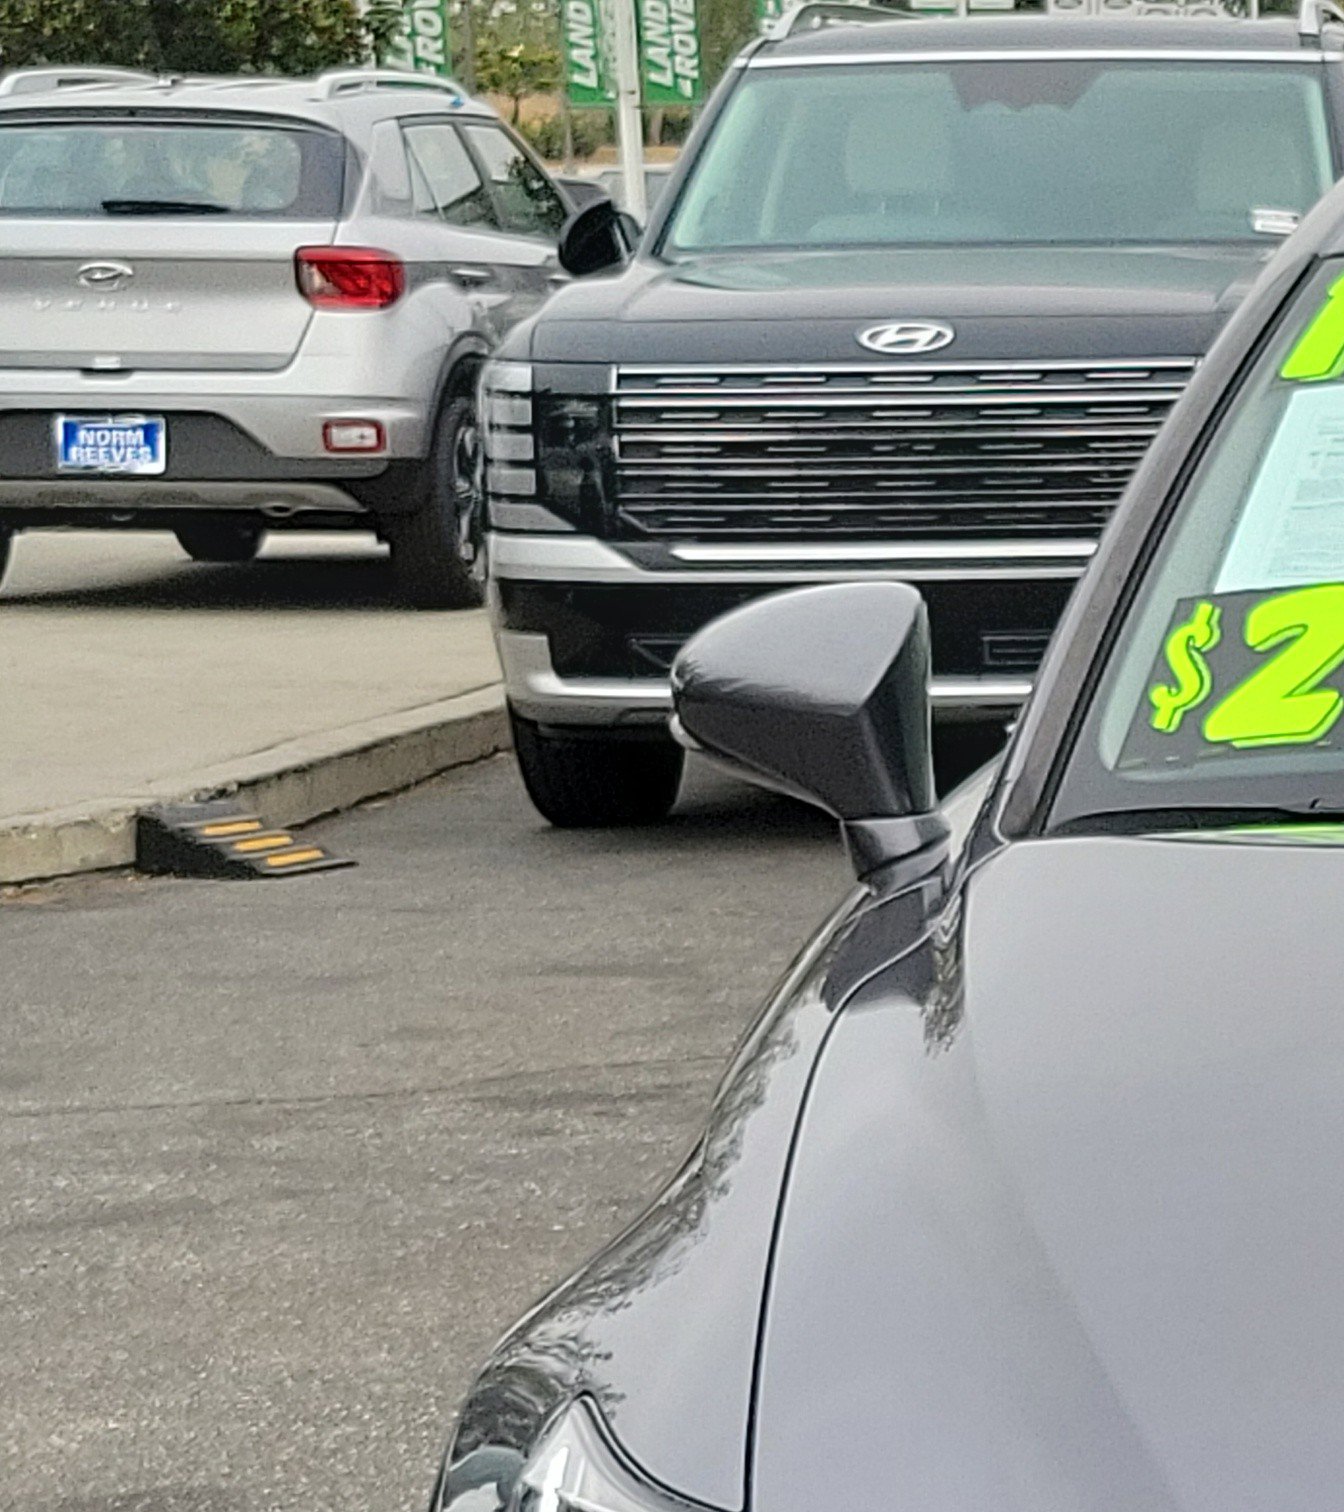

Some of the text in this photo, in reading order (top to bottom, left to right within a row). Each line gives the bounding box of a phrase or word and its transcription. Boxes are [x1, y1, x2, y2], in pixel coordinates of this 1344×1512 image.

[568, 0, 598, 88] LAND
[643, 0, 673, 87] LAND
[68, 446, 152, 464] REEVES
[78, 429, 145, 446] NORM
